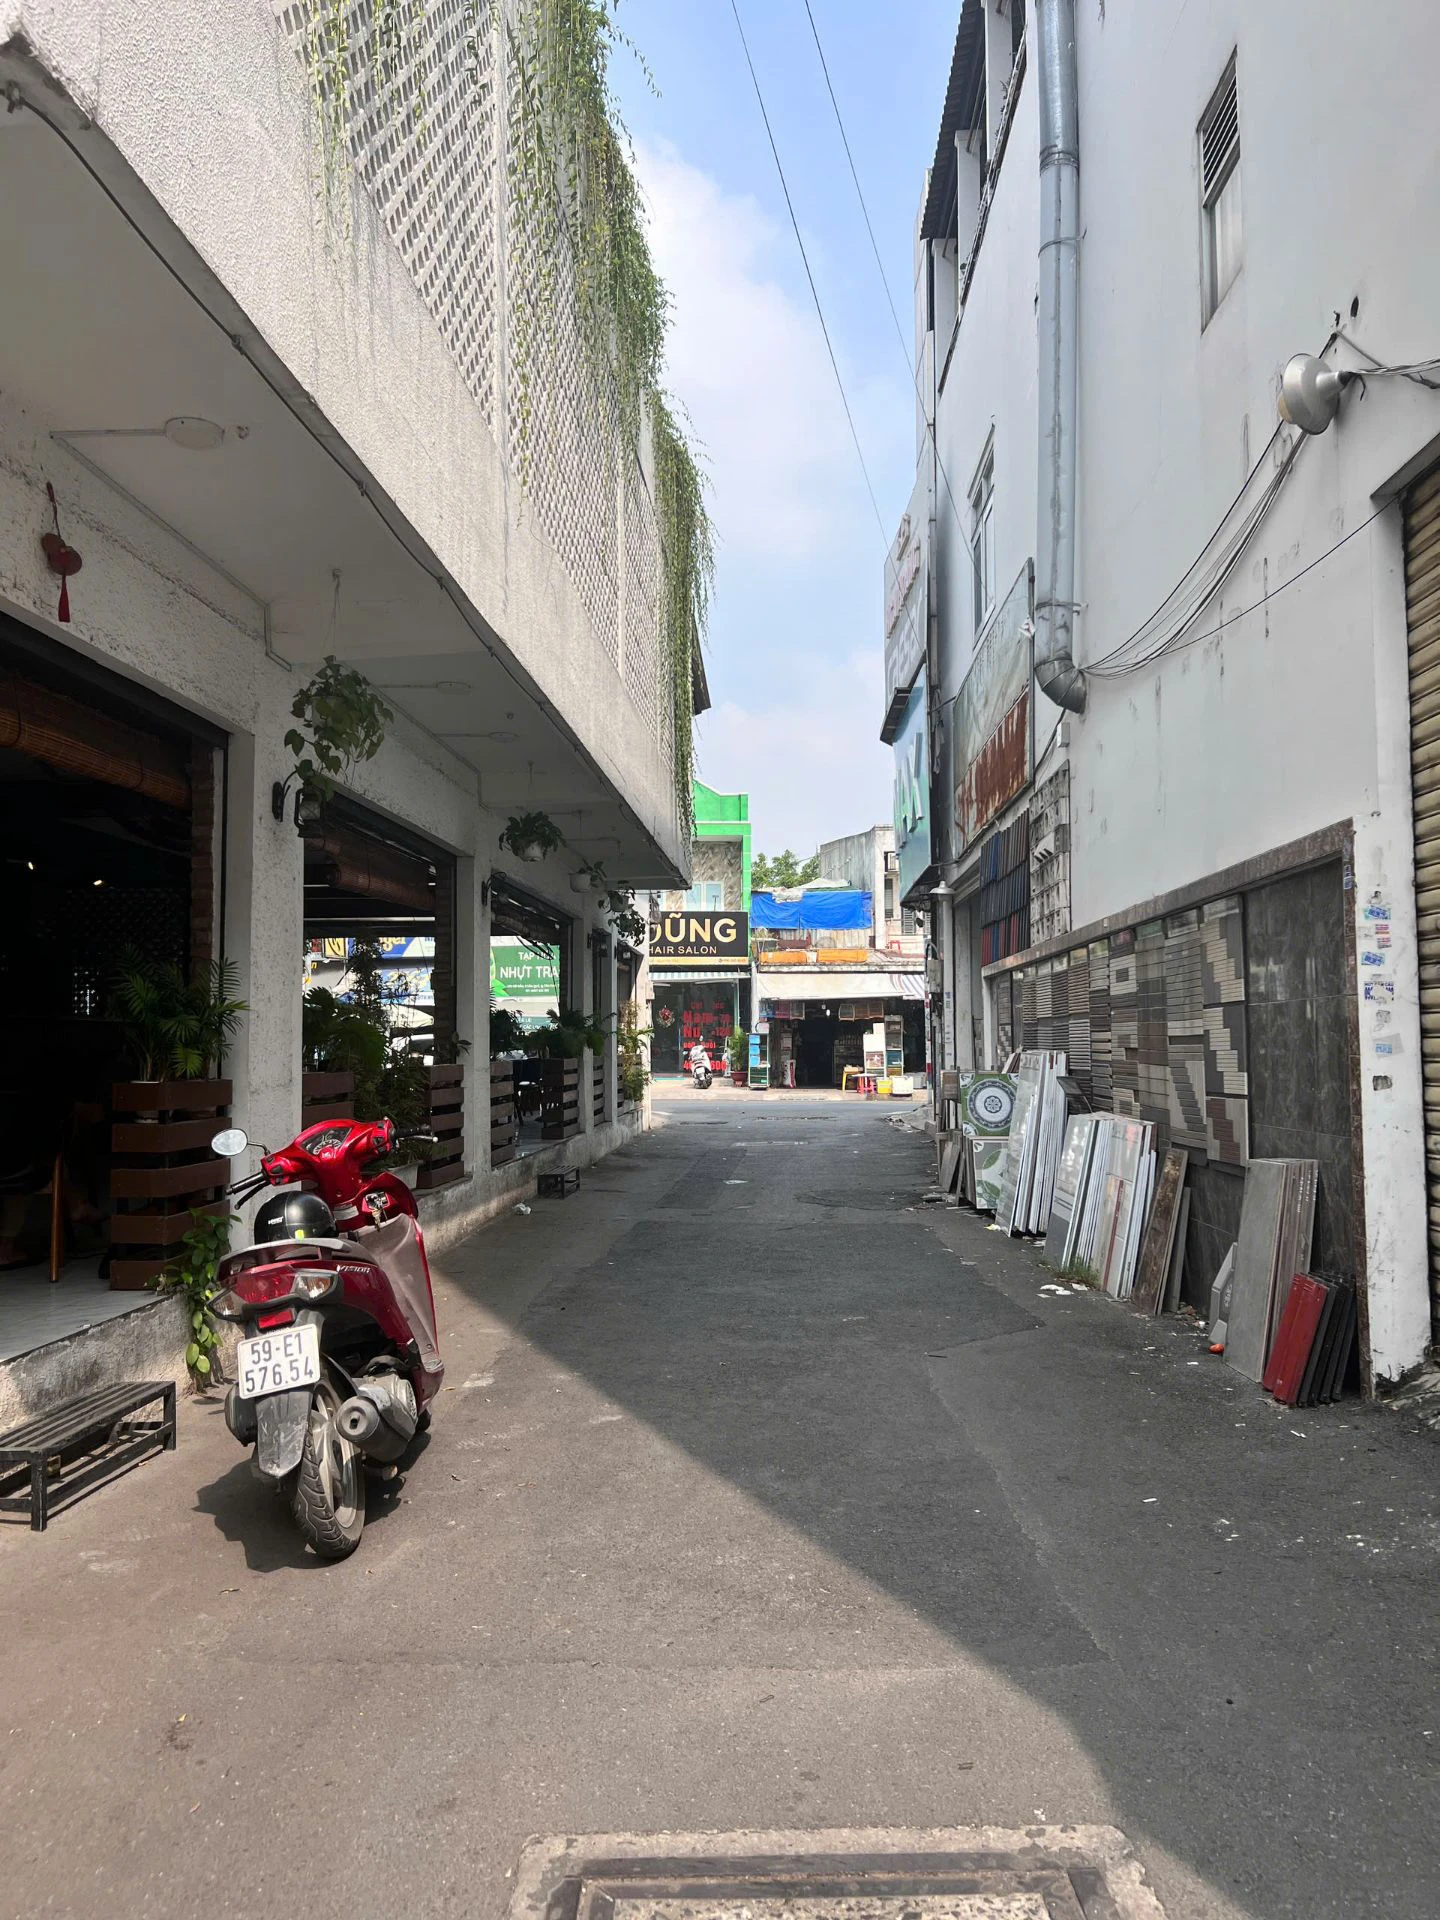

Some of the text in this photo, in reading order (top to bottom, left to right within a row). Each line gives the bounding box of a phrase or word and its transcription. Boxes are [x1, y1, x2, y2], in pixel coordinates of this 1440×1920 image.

[678, 945, 717, 954] SALON
[500, 964, 532, 980] NHỰT
[250, 1333, 304, 1366] 59-E1
[245, 1356, 314, 1394] 576.54
